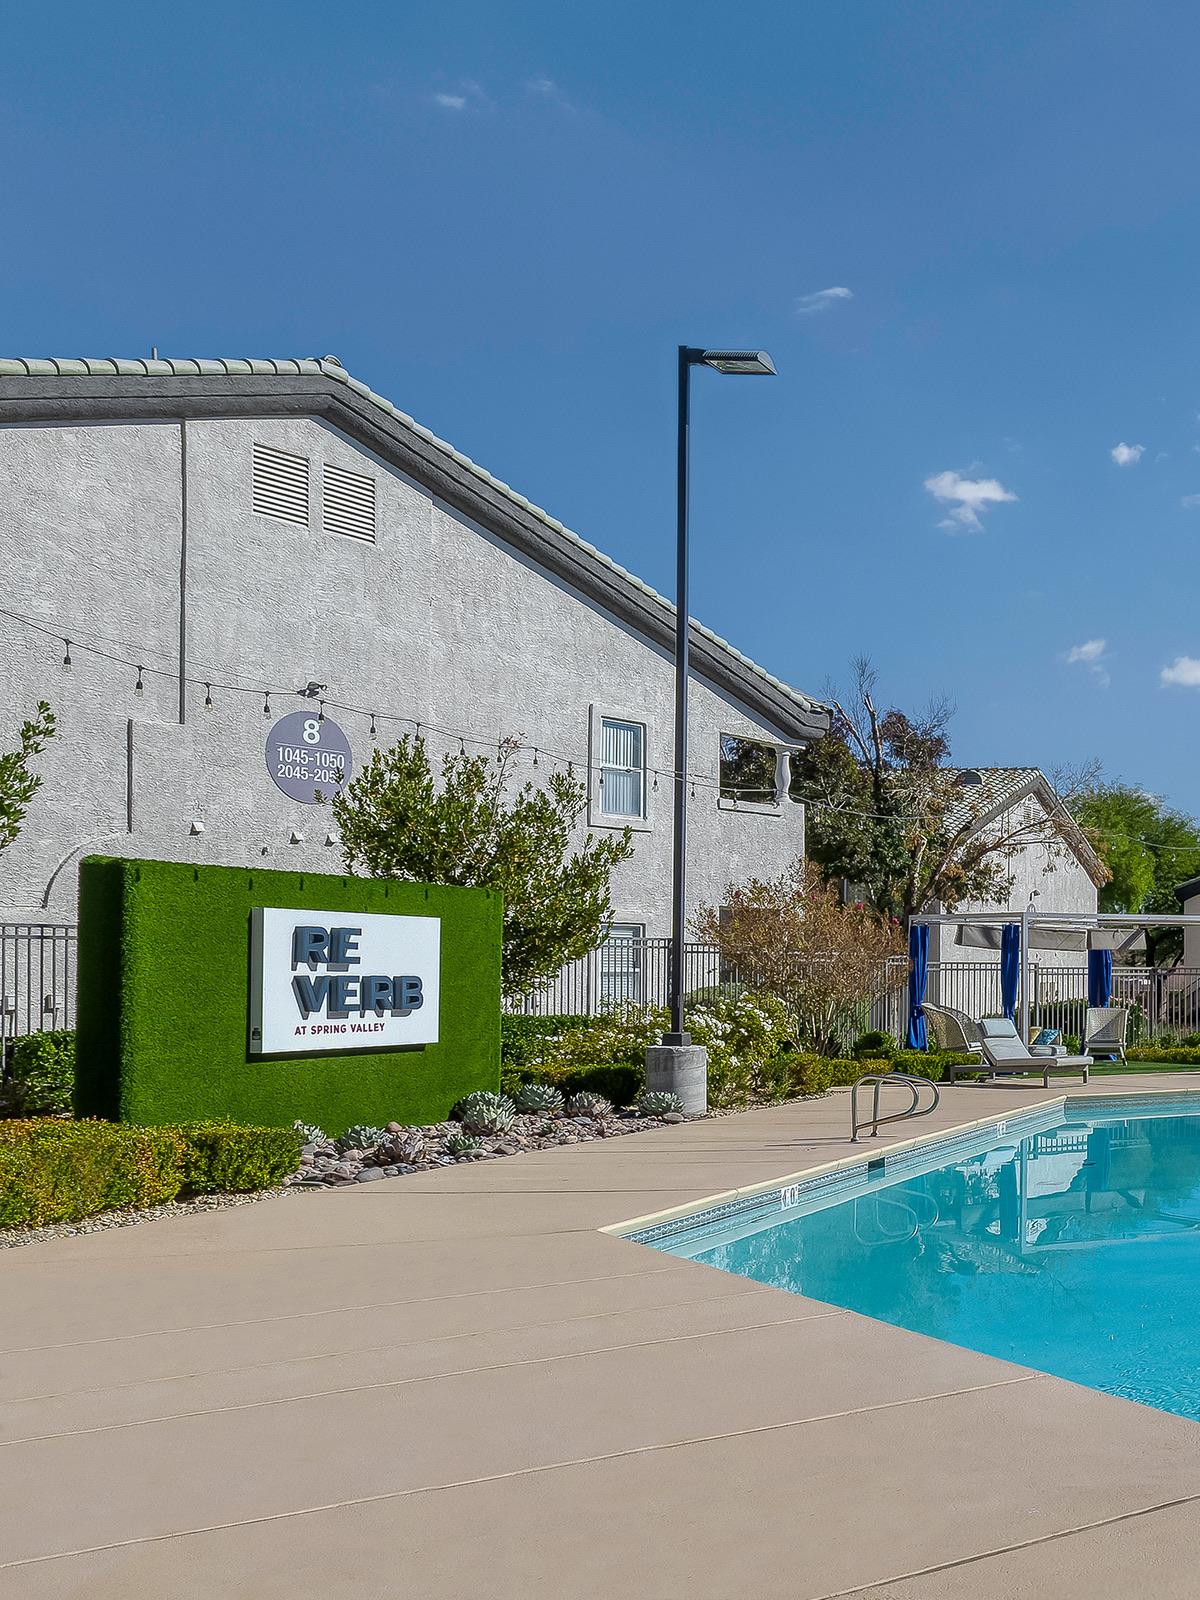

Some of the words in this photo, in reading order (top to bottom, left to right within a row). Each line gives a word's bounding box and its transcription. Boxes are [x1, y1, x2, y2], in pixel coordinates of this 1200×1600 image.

[303, 719, 320, 744] 8
[277, 747, 345, 769] 1045-1050
[277, 764, 345, 785] 2045-205
[291, 926, 362, 971] RE
[291, 975, 424, 1020] VERB
[294, 1026, 307, 1035] AT
[310, 1024, 347, 1035] SPRING
[350, 1022, 386, 1033] VALLEY
